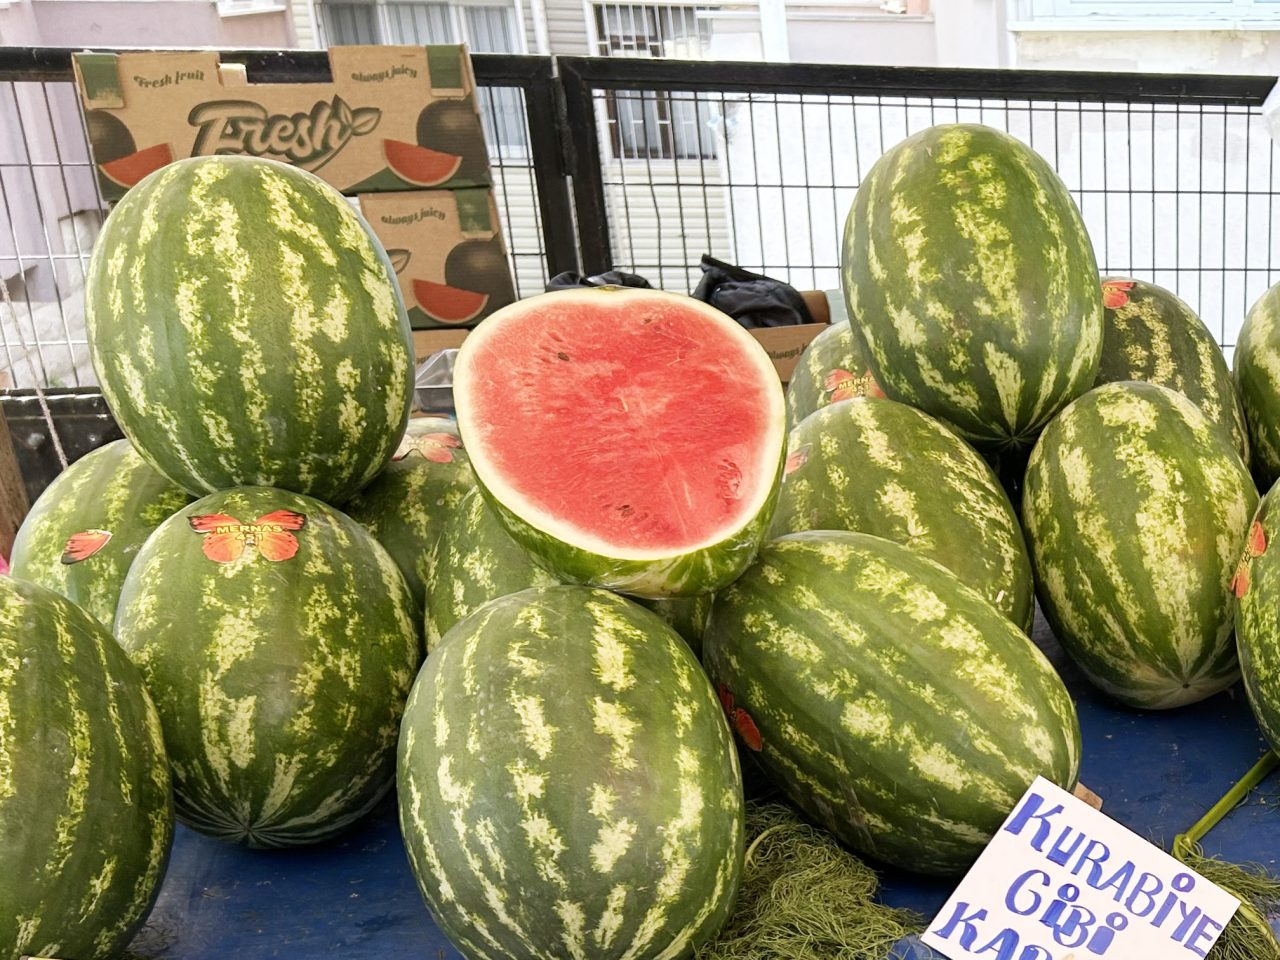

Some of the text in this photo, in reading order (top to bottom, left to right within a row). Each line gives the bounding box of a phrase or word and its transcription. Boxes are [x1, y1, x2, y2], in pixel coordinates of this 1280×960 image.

[175, 70, 205, 85] fruit
[188, 99, 348, 163] Fresh
[417, 207, 446, 223] juicy
[216, 525, 282, 534] MERNAS
